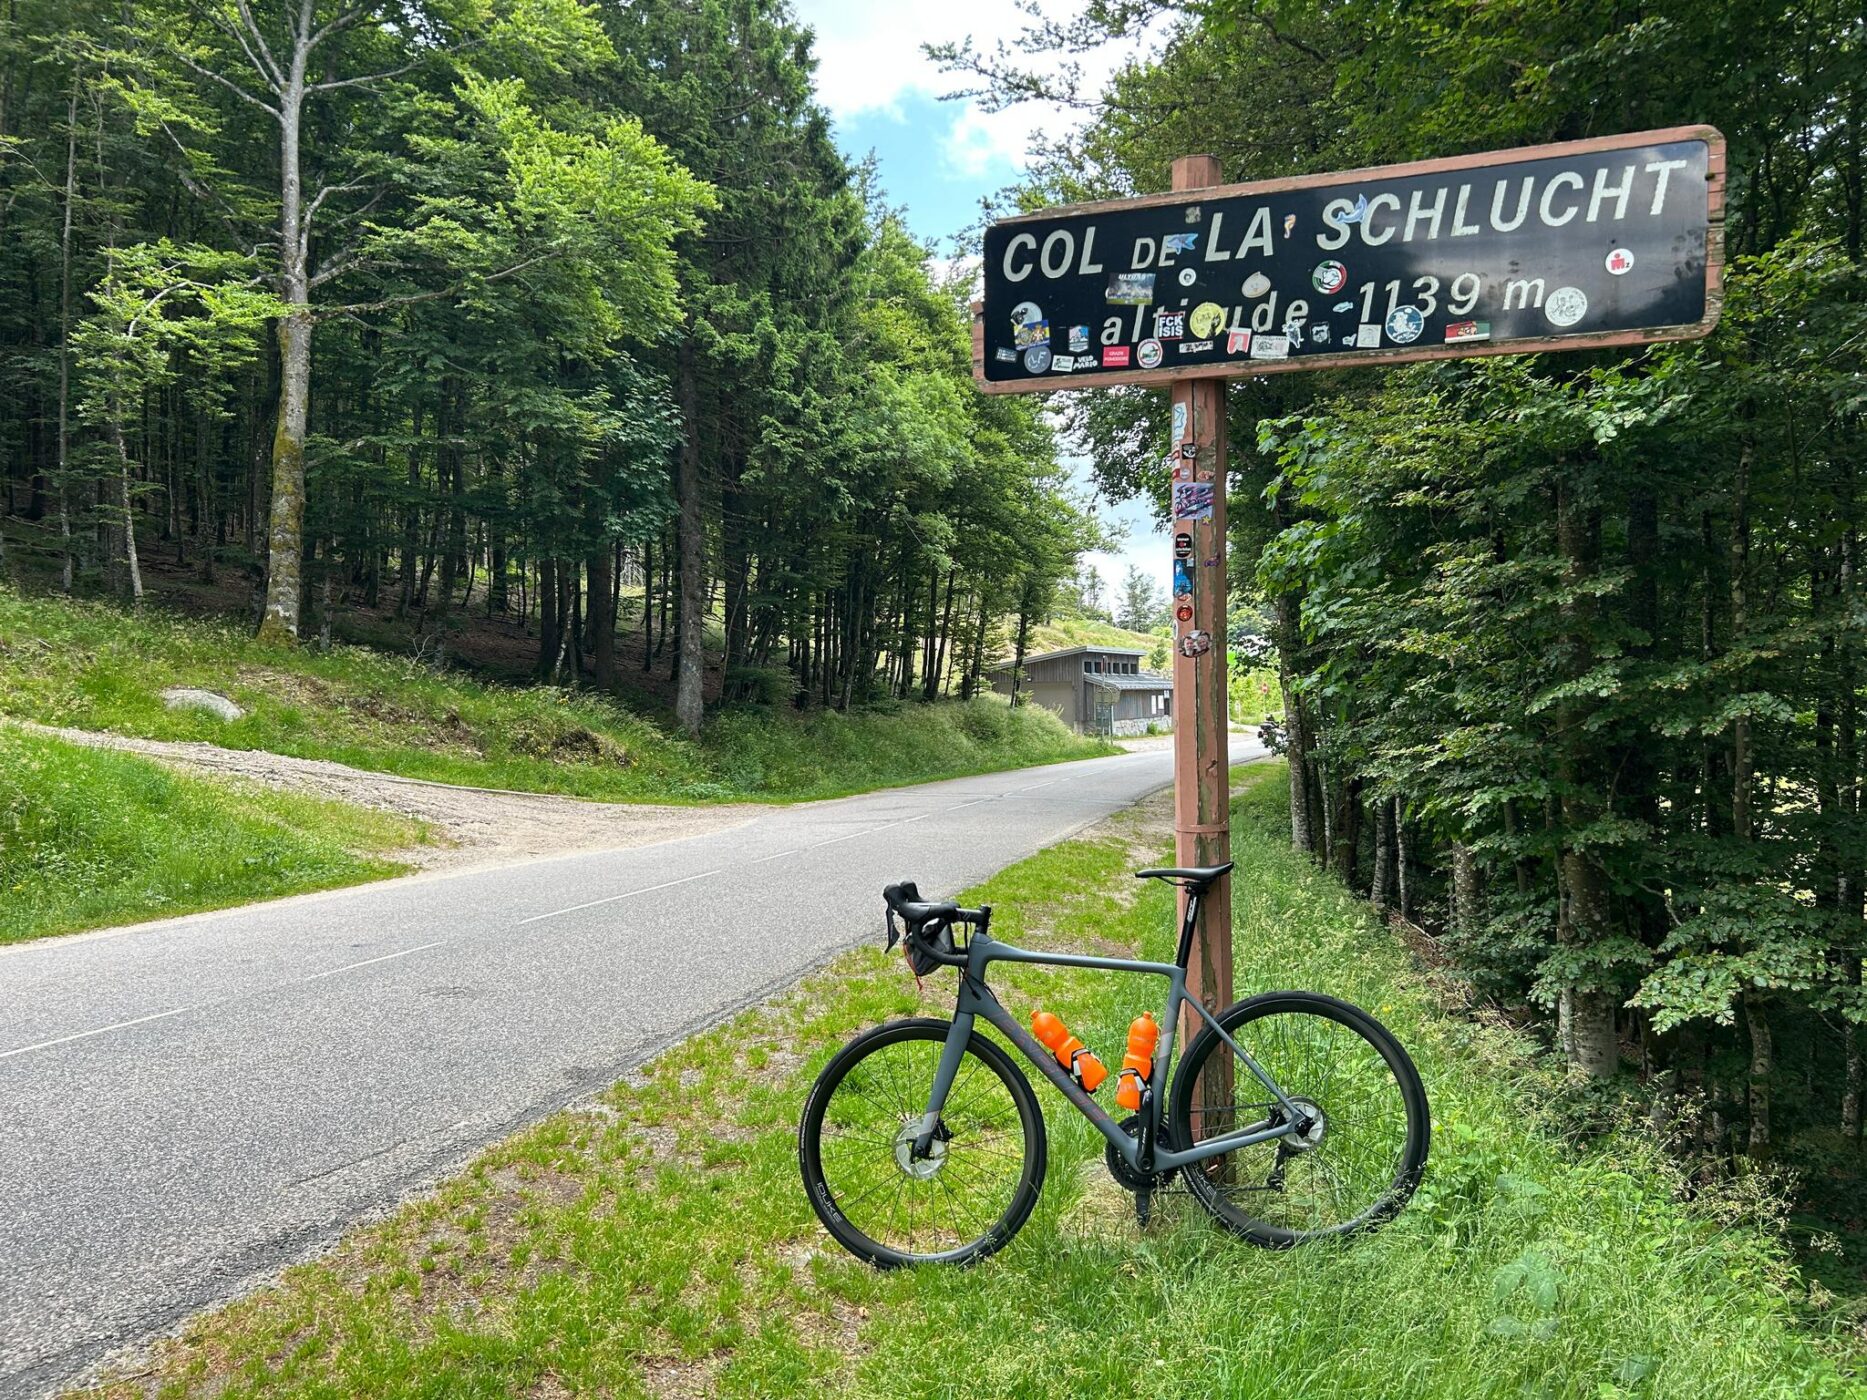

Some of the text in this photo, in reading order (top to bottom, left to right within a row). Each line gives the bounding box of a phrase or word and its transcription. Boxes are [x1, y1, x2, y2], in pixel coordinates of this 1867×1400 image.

[1003, 159, 1687, 282] COL DE LA SCHLUCHT
[1100, 272, 1545, 345] altude 1139 m
[1159, 315, 1184, 327] FCK
[1159, 325, 1183, 338] ISIS
